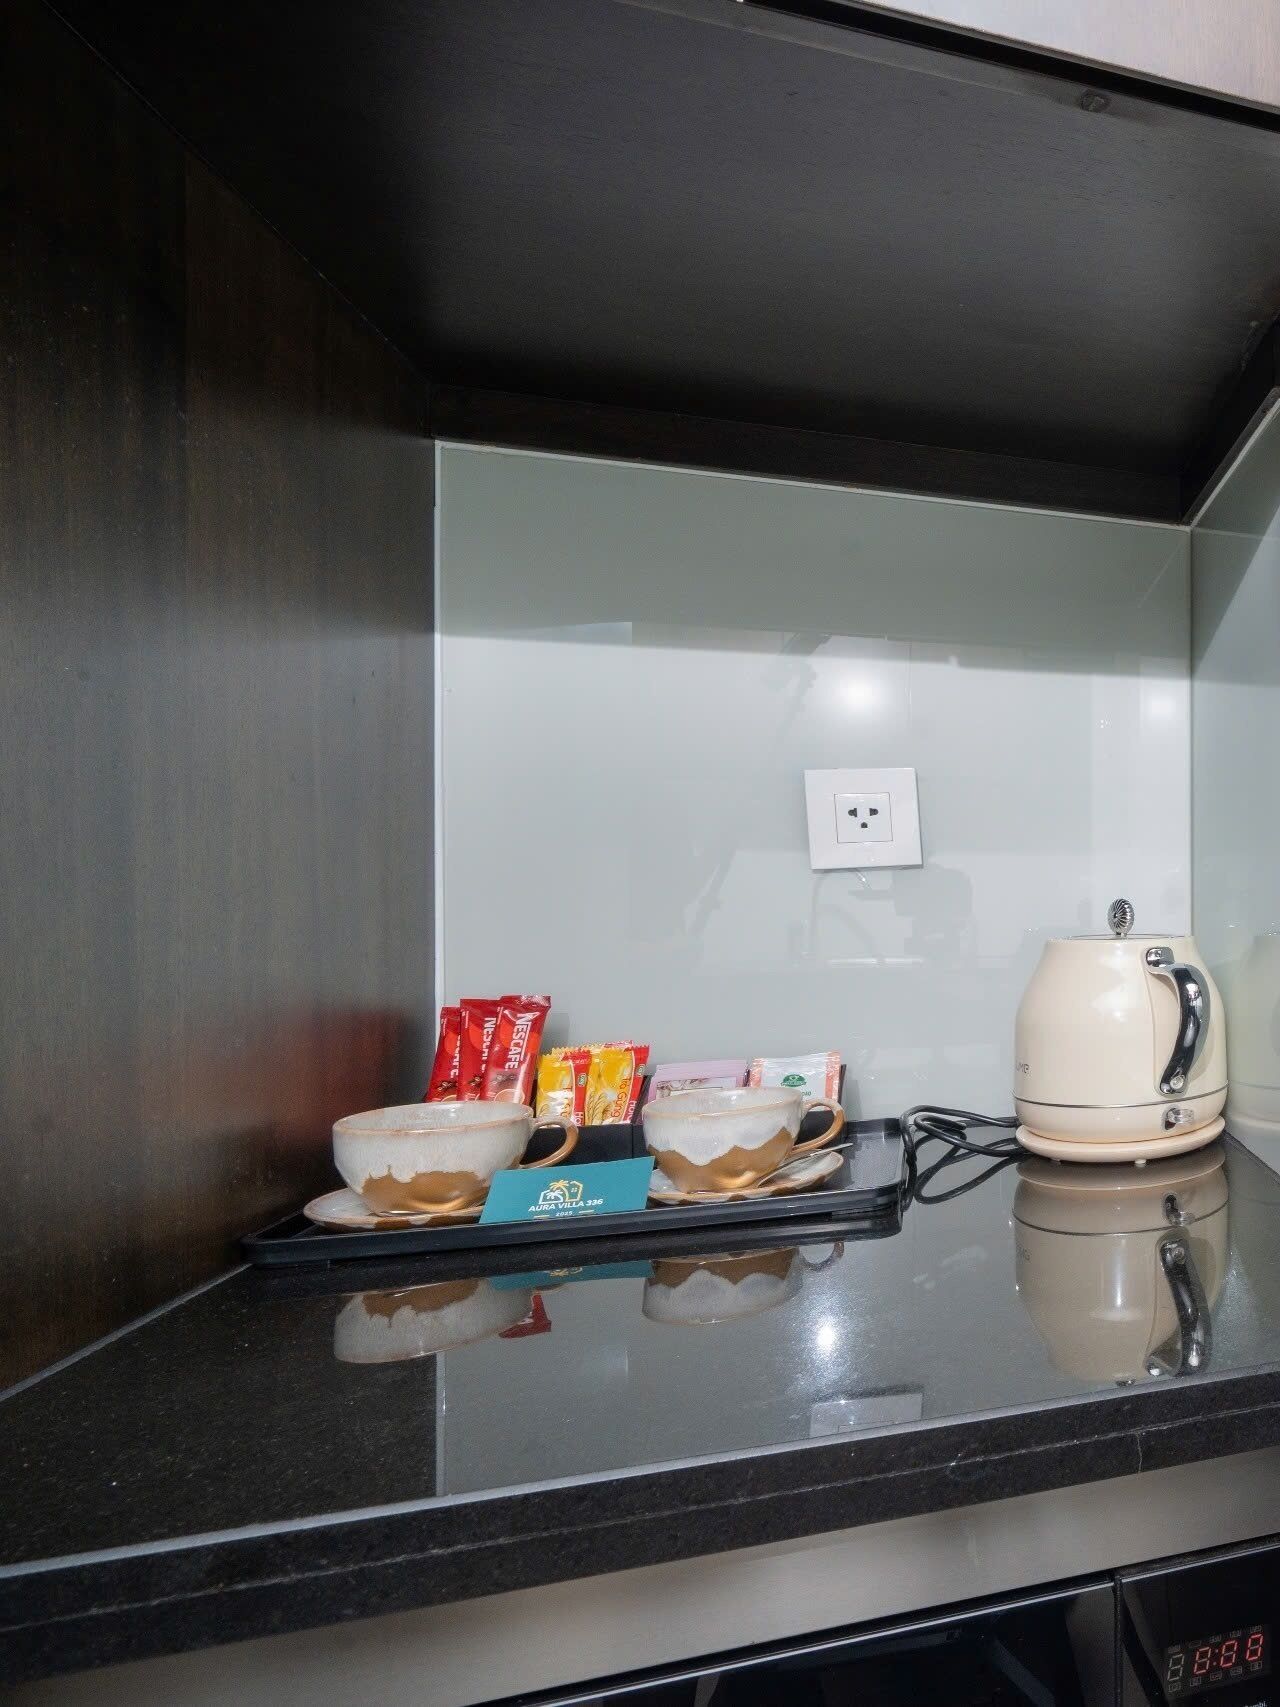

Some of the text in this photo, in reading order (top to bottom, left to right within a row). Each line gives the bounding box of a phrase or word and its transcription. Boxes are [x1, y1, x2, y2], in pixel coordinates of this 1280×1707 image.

[528, 1198, 604, 1212] AURA VILLA 336
